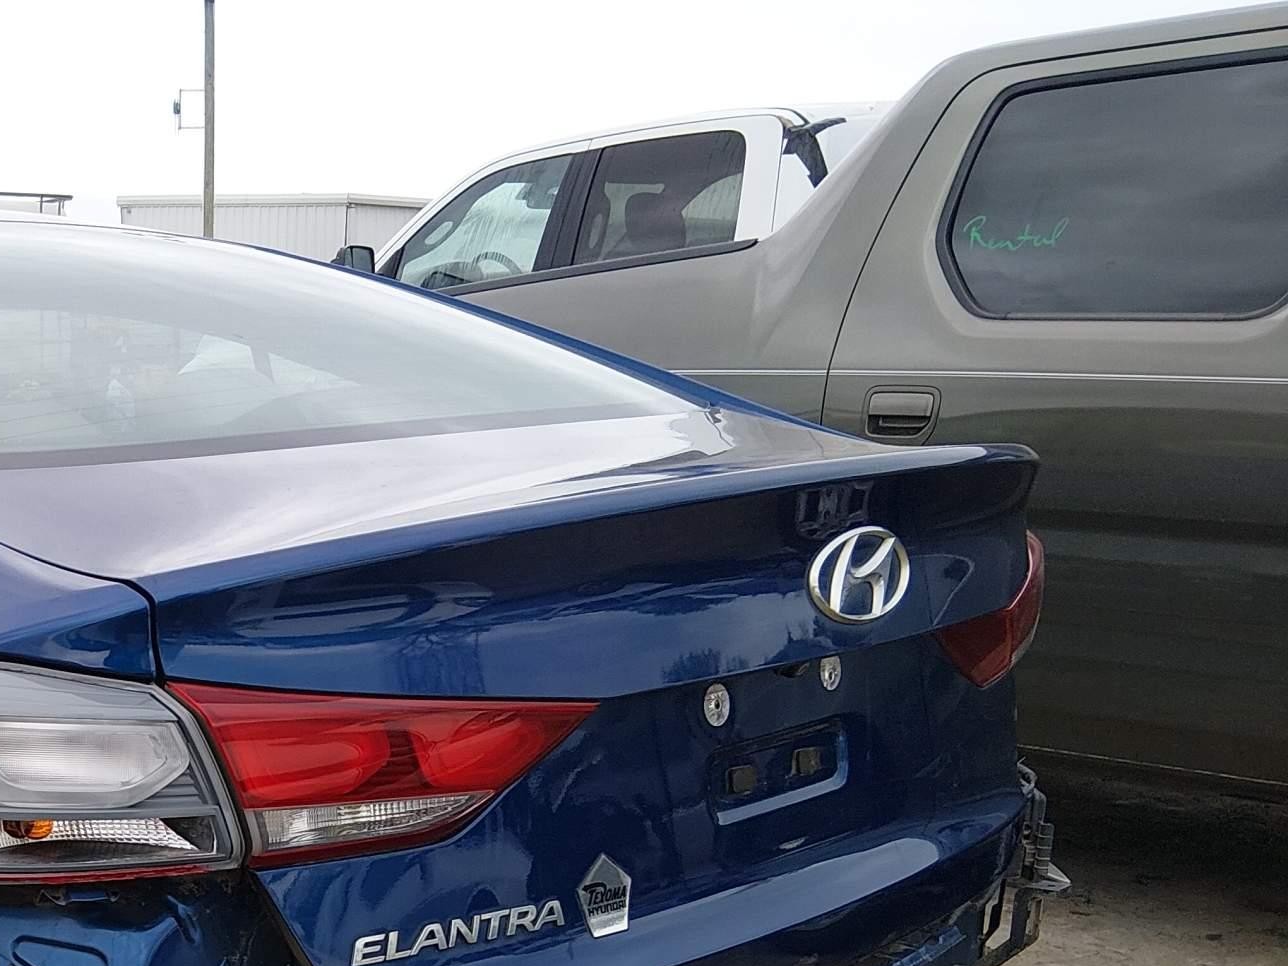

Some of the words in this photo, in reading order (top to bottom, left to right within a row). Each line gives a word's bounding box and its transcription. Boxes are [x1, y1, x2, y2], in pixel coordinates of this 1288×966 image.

[963, 215, 1070, 251] Rental
[588, 900, 627, 917] HYUNDAI
[350, 900, 565, 966] ELANTRA
